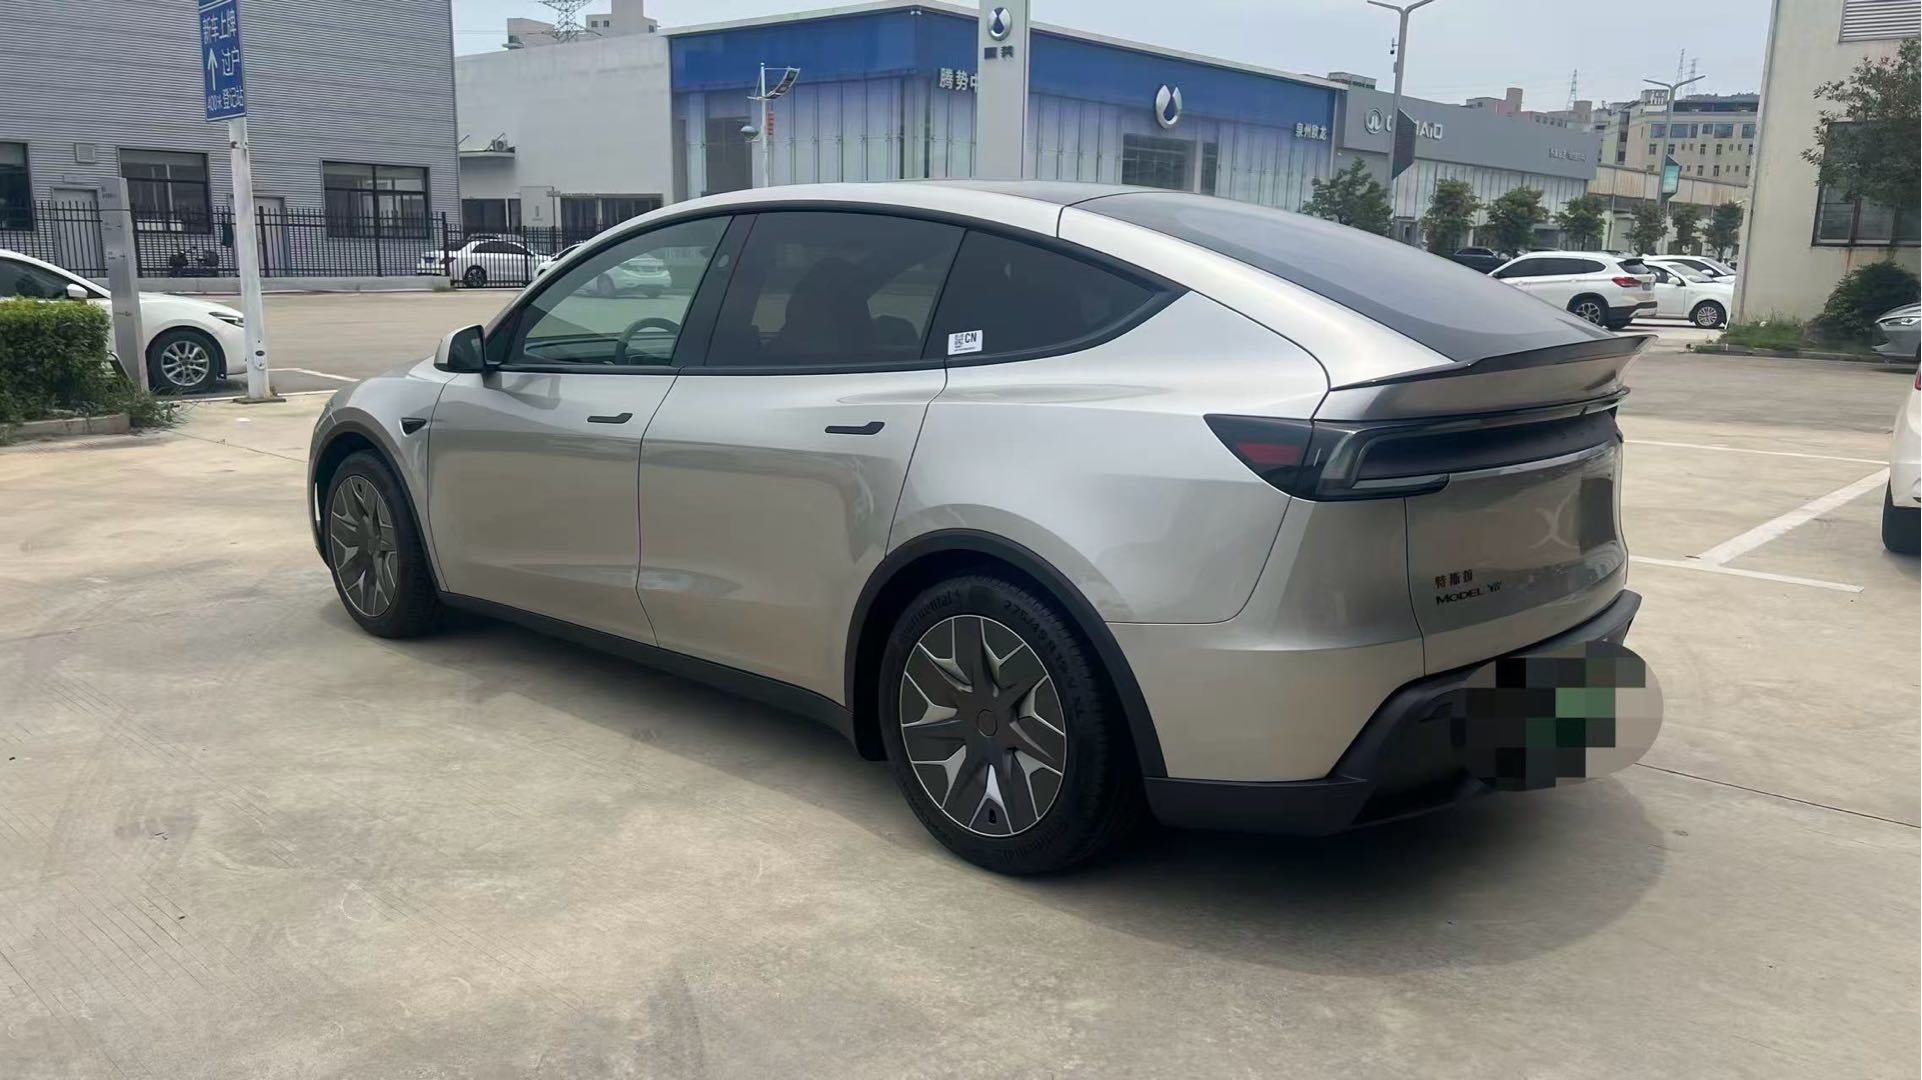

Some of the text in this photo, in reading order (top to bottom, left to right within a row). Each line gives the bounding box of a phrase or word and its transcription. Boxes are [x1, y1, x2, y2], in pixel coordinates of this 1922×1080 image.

[203, 8, 237, 45] 新车上牌
[222, 46, 240, 76] 过户
[223, 85, 243, 109] 登记站
[964, 331, 977, 344] CN
[1435, 568, 1473, 589] 特斯拉
[1436, 588, 1482, 605] MODEL
